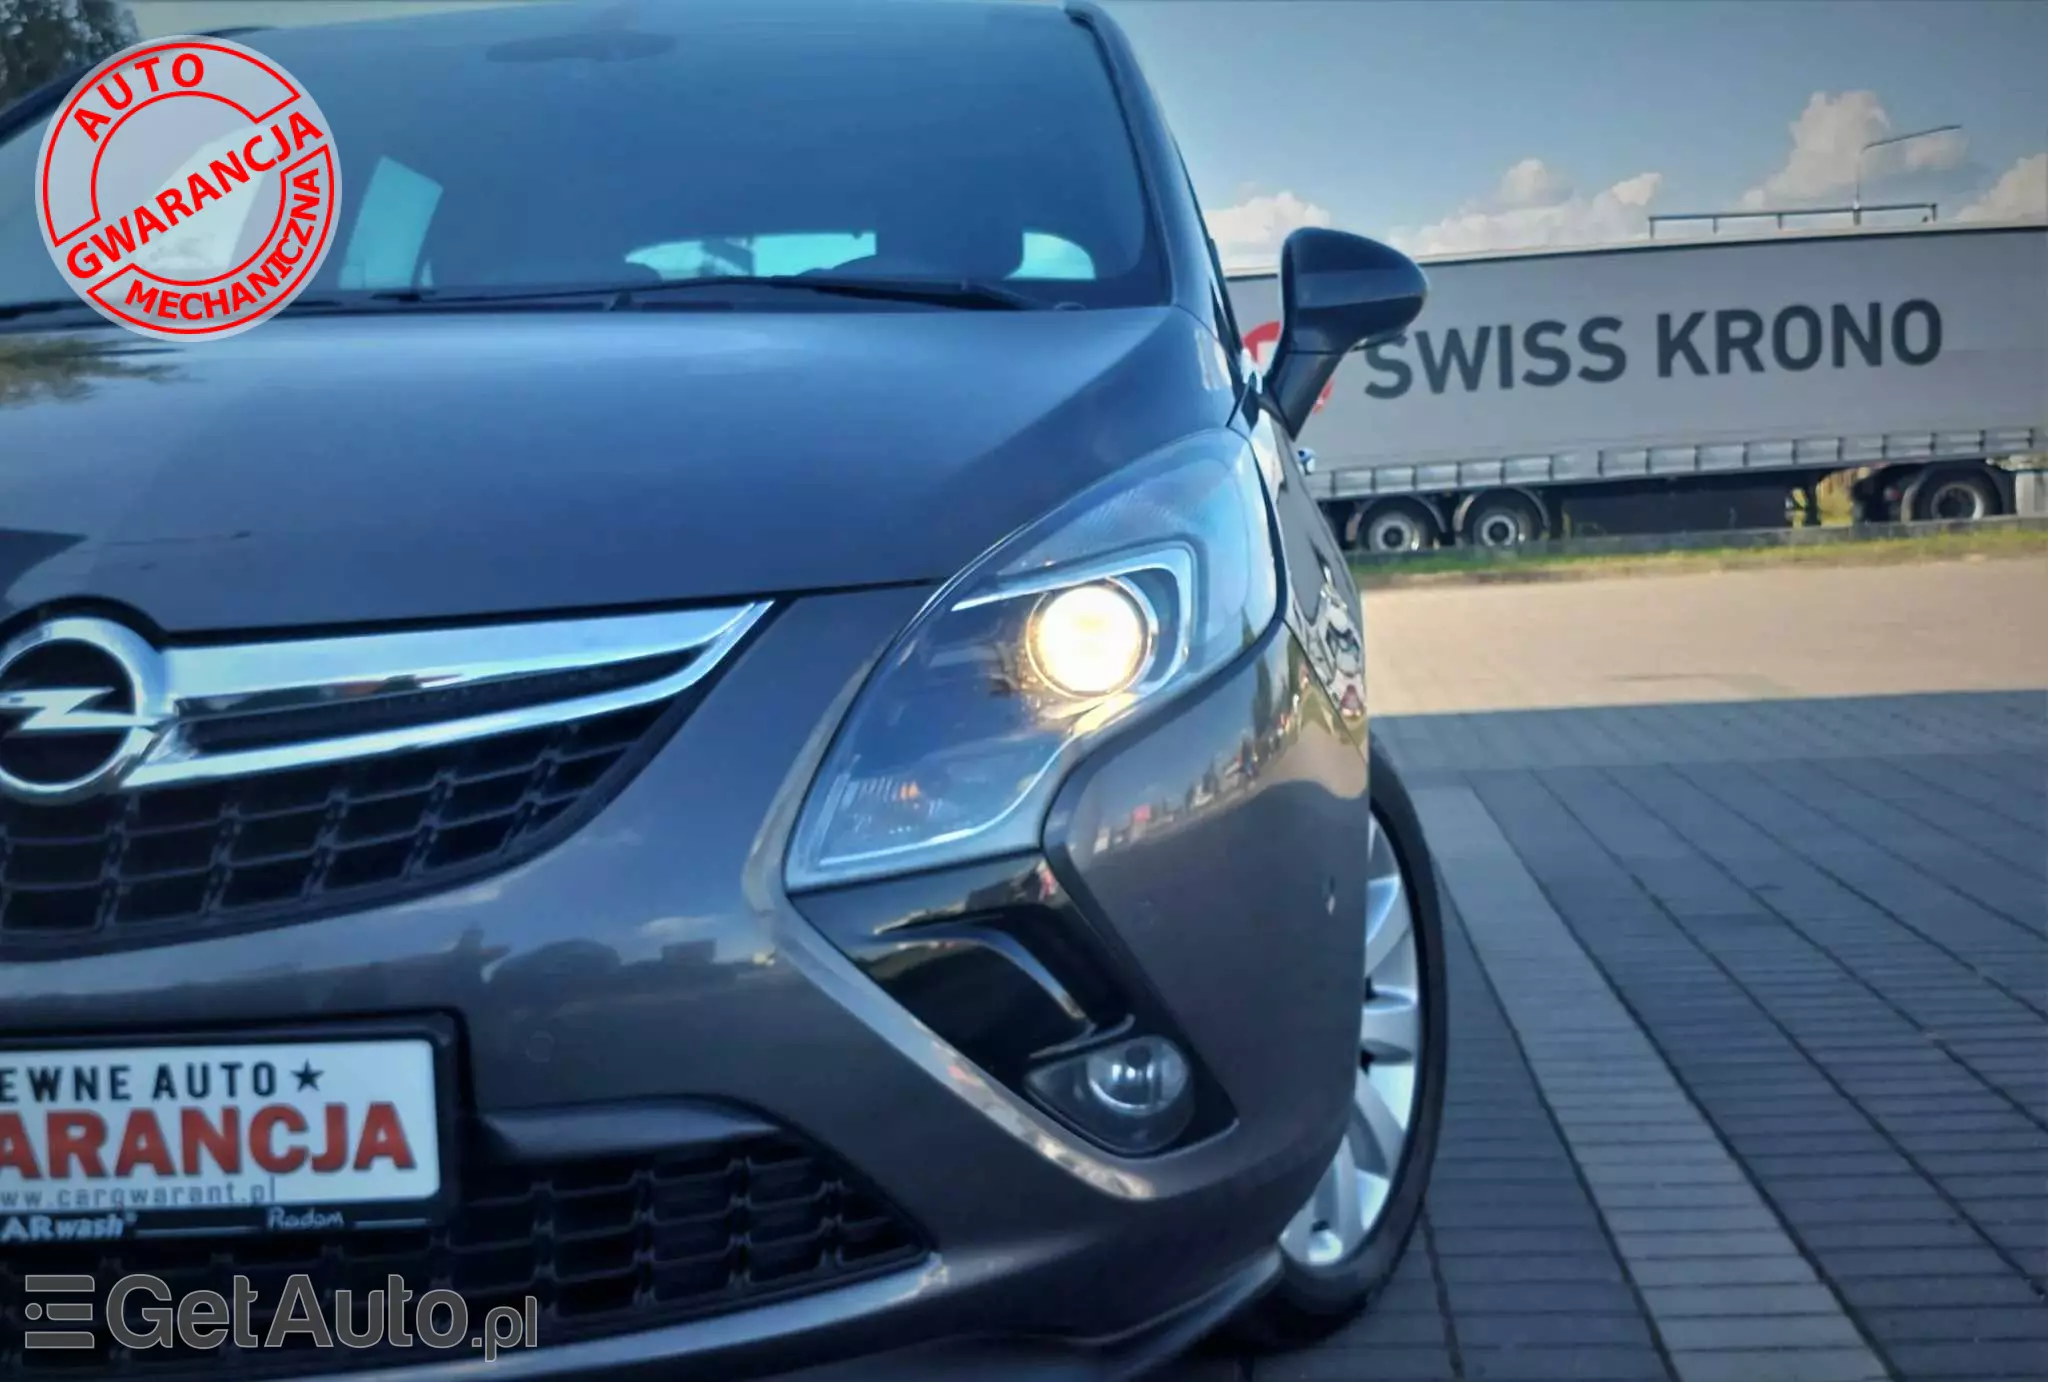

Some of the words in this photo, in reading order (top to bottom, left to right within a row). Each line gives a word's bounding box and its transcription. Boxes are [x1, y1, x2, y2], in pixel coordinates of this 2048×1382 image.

[1364, 316, 1626, 400] SWISS
[1656, 299, 1942, 379] KRONO
[152, 1062, 277, 1100] AUTO
[0, 1101, 416, 1180] ARANCJA
